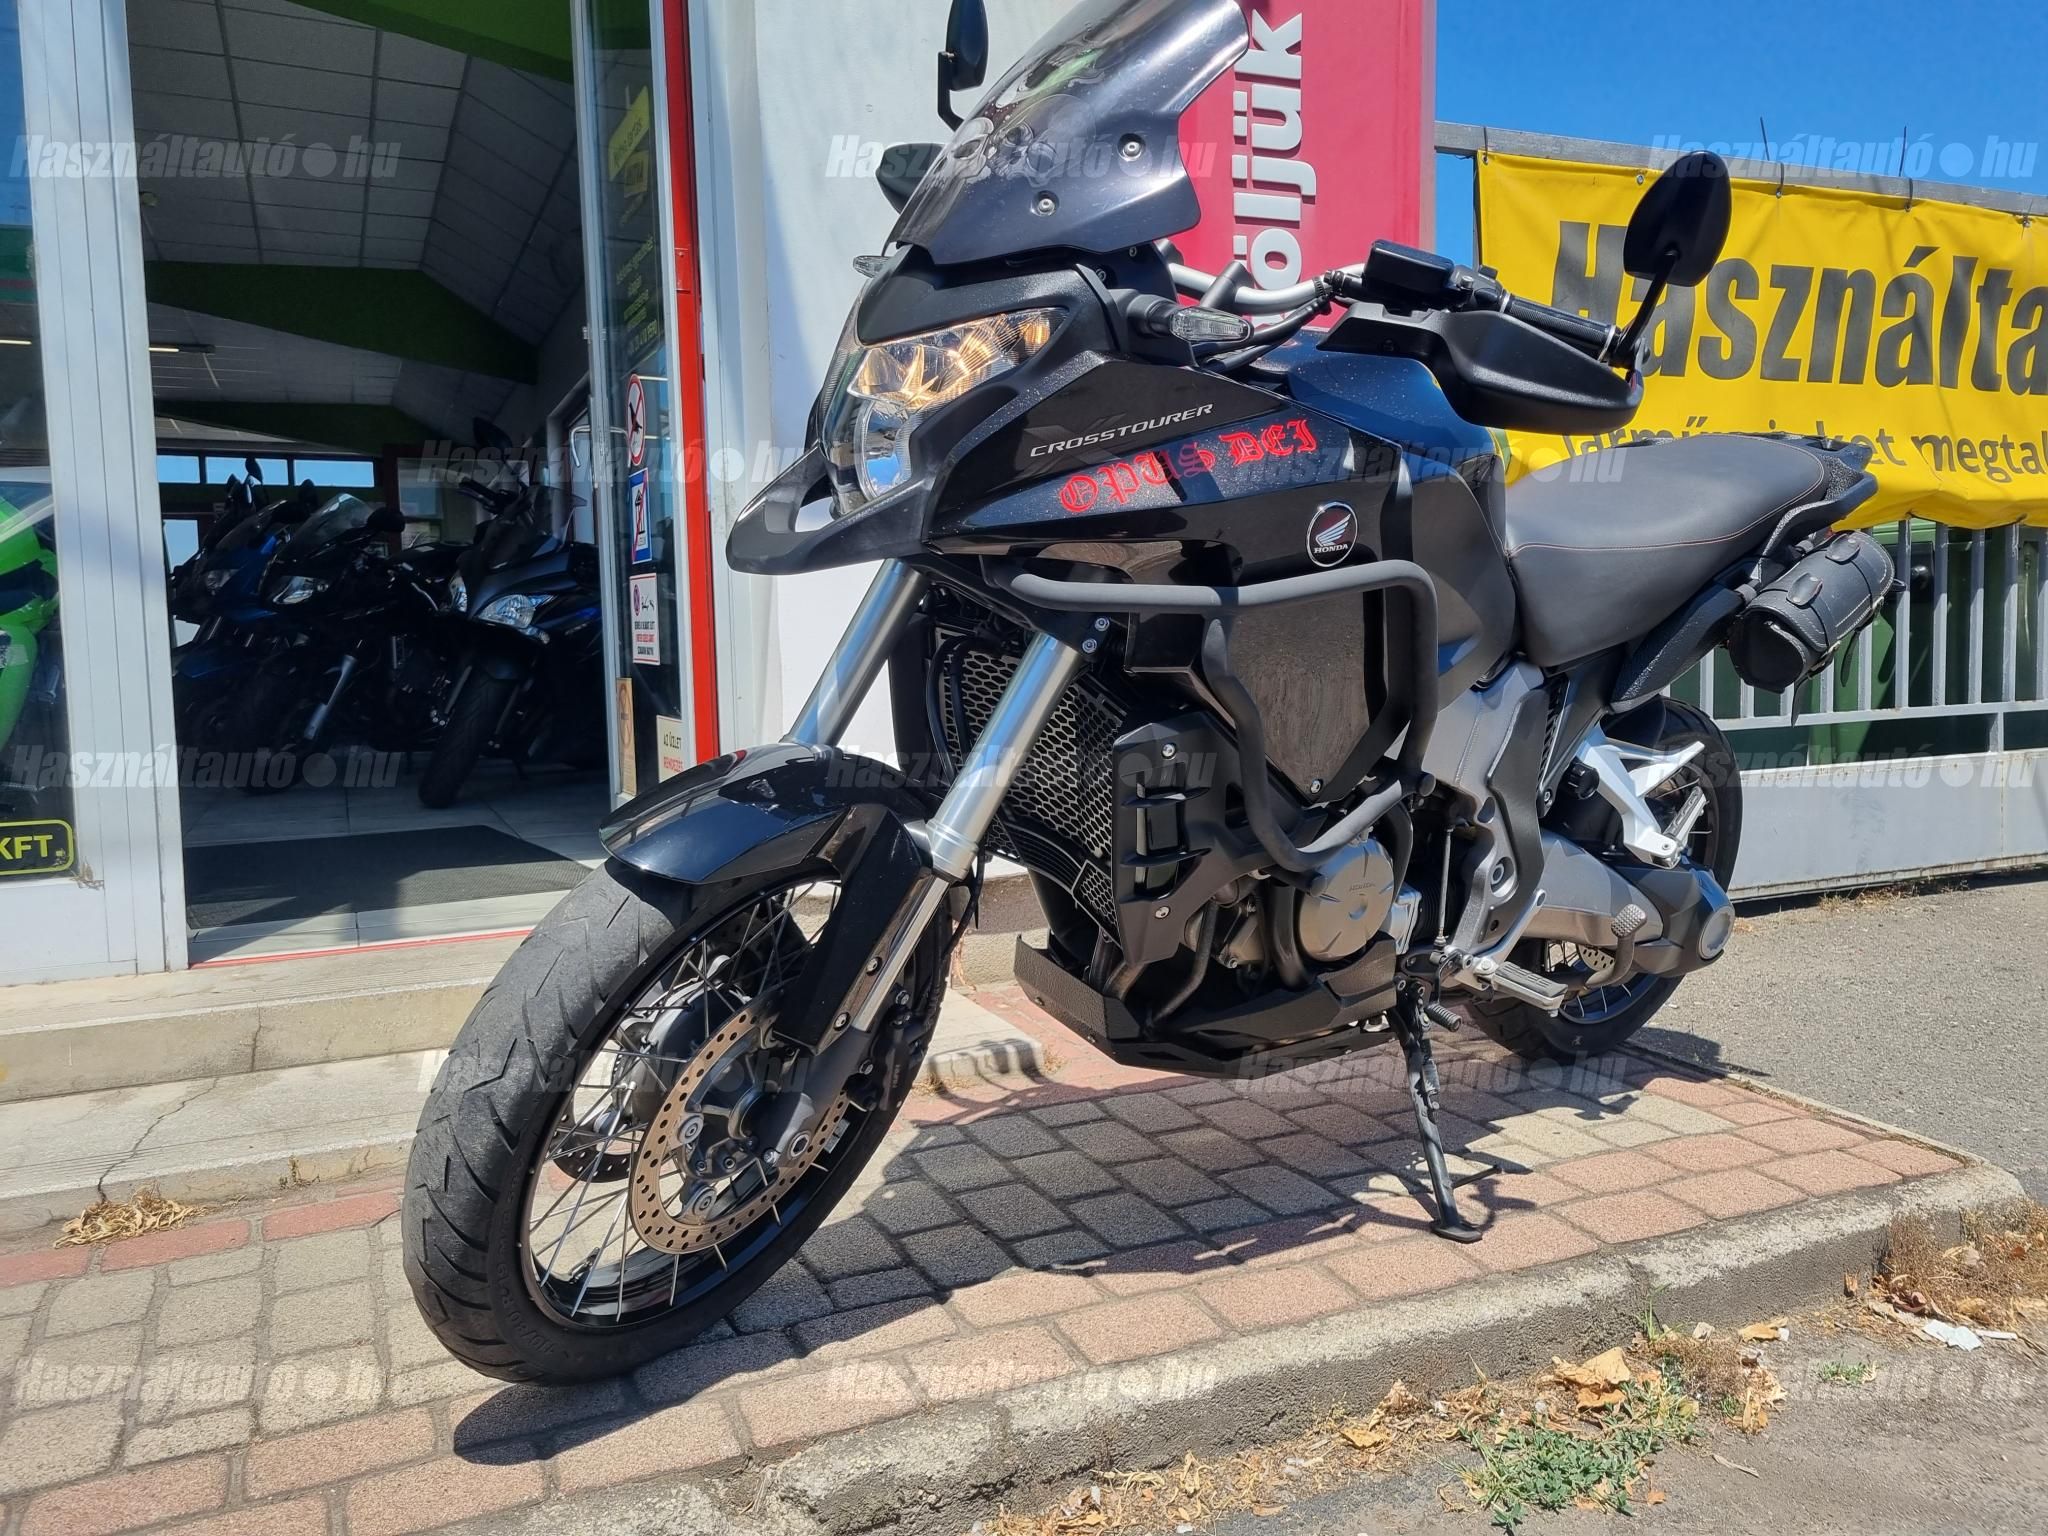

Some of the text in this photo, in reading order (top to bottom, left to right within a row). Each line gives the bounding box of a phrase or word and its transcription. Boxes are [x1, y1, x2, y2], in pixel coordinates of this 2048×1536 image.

[1030, 403, 1214, 457] CROSSTOURER
[1219, 417, 1318, 467] DEI
[1314, 543, 1348, 553] HONDA
